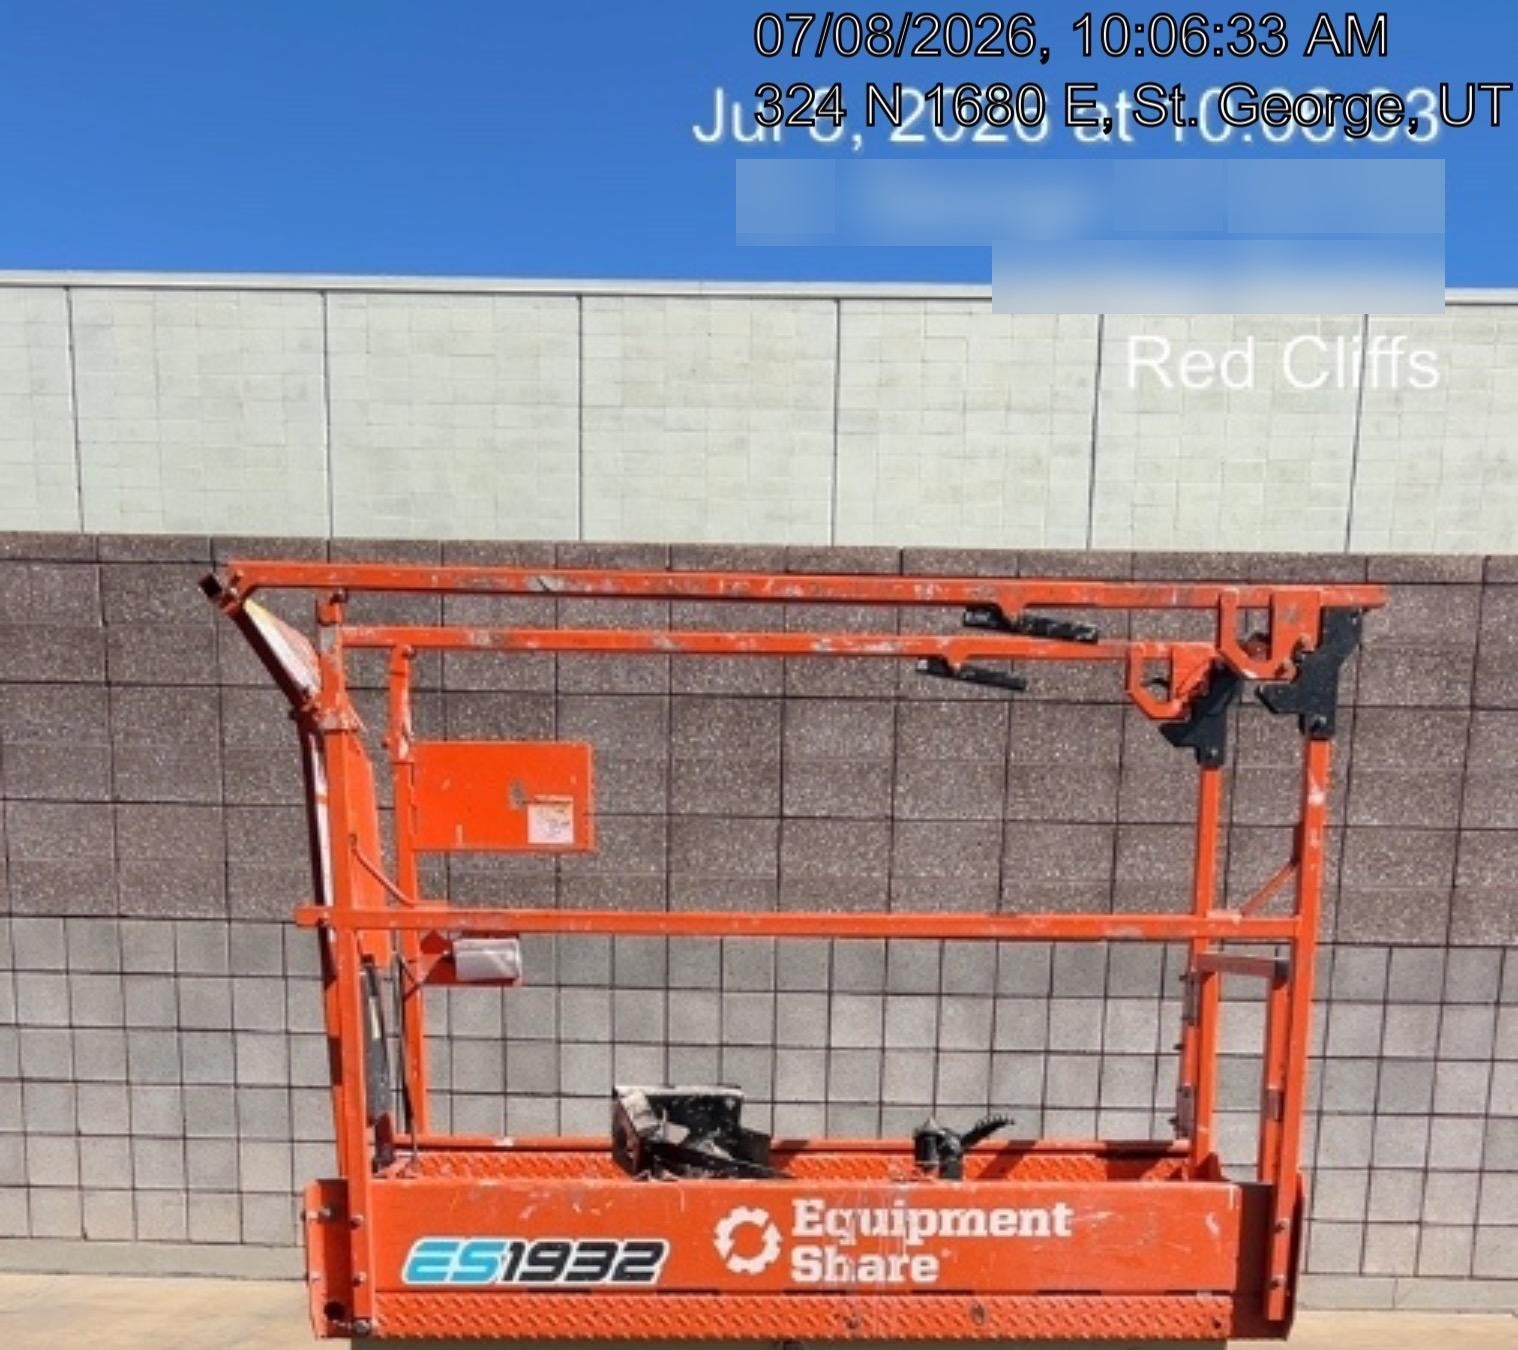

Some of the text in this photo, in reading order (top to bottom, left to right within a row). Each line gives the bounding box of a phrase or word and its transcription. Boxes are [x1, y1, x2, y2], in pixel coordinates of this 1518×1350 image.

[791, 1198, 1074, 1246] Equipment
[402, 1237, 670, 1285] ES1932
[790, 1244, 940, 1283] Share
